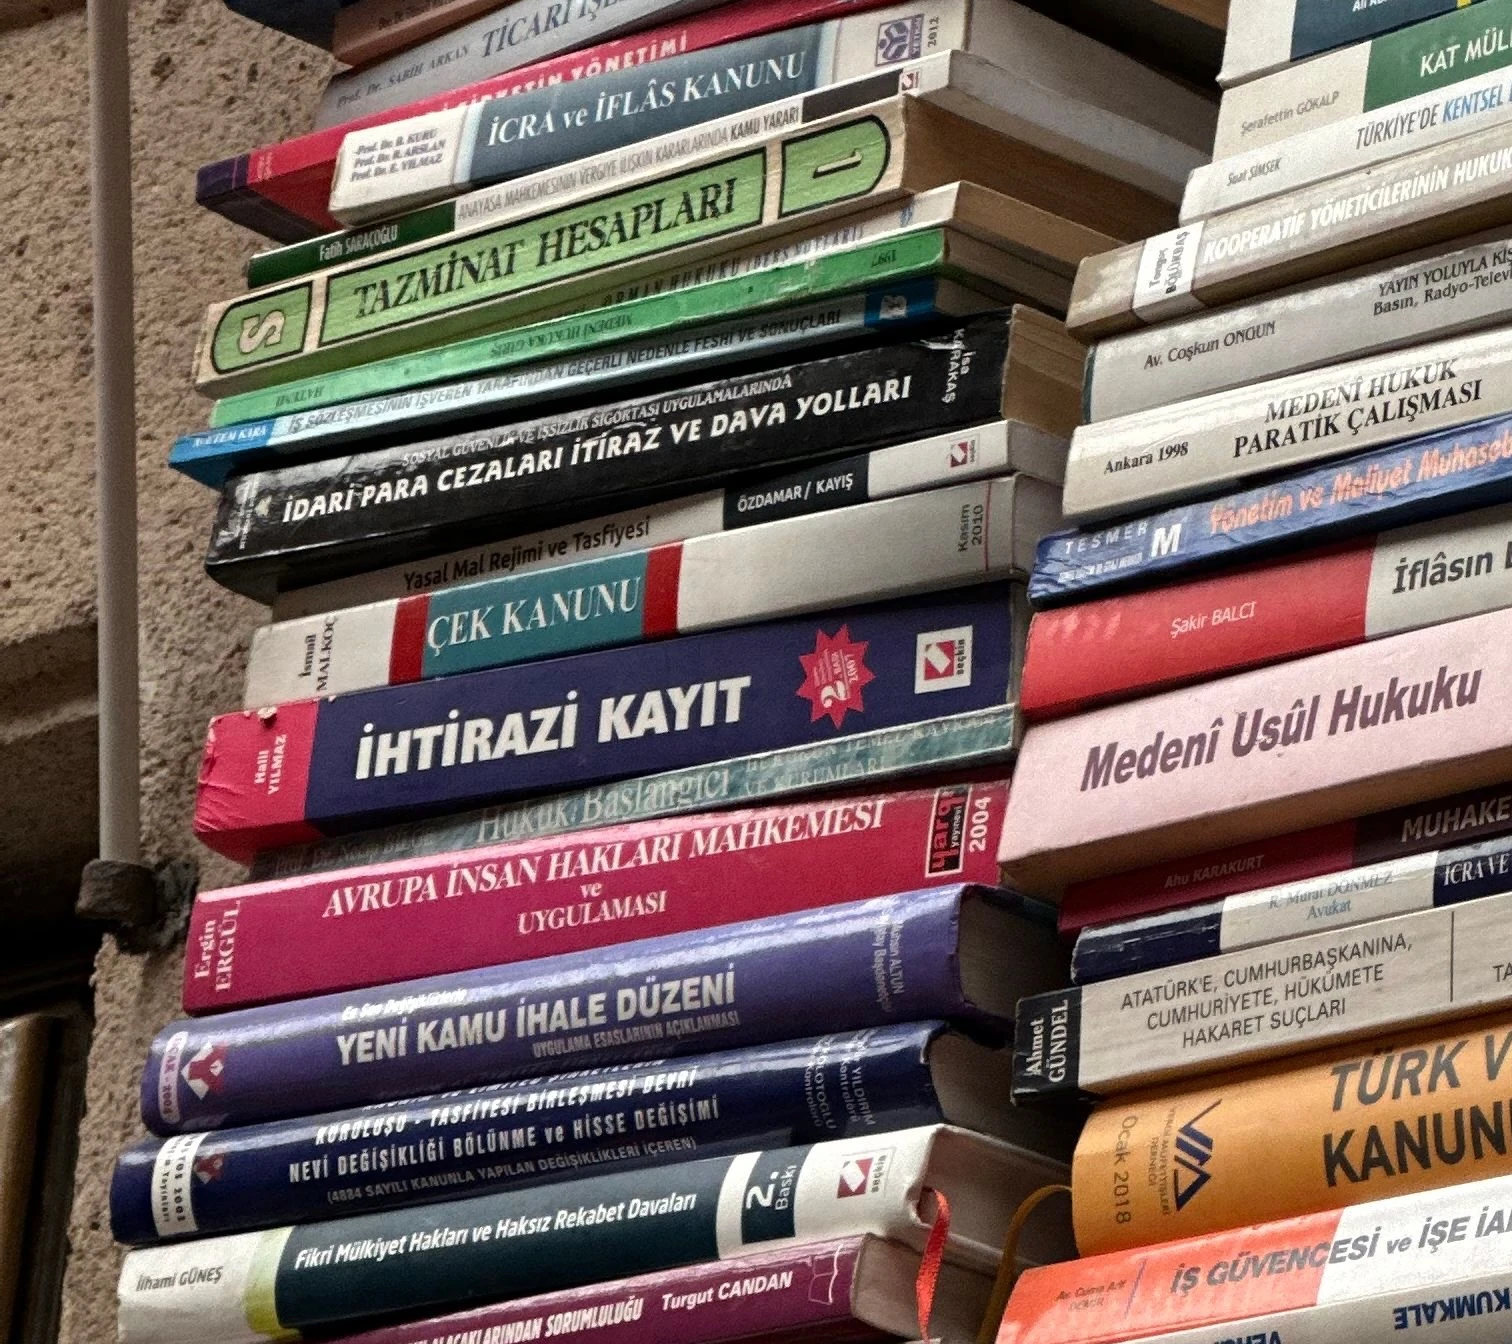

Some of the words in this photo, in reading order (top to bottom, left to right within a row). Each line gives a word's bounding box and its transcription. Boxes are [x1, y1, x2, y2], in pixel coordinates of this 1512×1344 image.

[1420, 46, 1458, 78] KAT
[353, 252, 518, 320] TAZMİNAT
[536, 177, 736, 266] HESAPLARI
[1104, 454, 1153, 475] Ankara
[1159, 441, 1189, 464] 1998
[1233, 415, 1339, 458] PARATİK
[1348, 380, 1482, 435] ÇALIŞMASI
[1393, 552, 1493, 594] İflâsın
[427, 602, 496, 656] ÇEK
[502, 576, 641, 633] KANUNU
[358, 691, 578, 780] İHTİRAZİ
[598, 675, 752, 744] KAYIT
[1080, 725, 1227, 792] Medenî
[1231, 697, 1323, 759] Usûl
[1329, 665, 1482, 736] Hukuku
[323, 872, 440, 920] AVRUPA
[447, 851, 542, 896] İNSAN
[548, 830, 683, 882] HAKLARI
[517, 891, 667, 936] UYGULAMASI
[337, 1016, 410, 1065] YENİ
[417, 1007, 507, 1056] KAMU
[515, 986, 607, 1043] İHALE
[617, 962, 735, 1030] DÜZENİ
[1330, 1036, 1477, 1113] TÜRK
[1169, 1255, 1202, 1295] İŞ
[1208, 1225, 1380, 1288] GÜVENCESİ
[1385, 1232, 1413, 1253] ve
[1418, 1209, 1468, 1252] İŞE
[662, 1284, 714, 1313] Turgut
[718, 1271, 793, 1303] CANDAN
